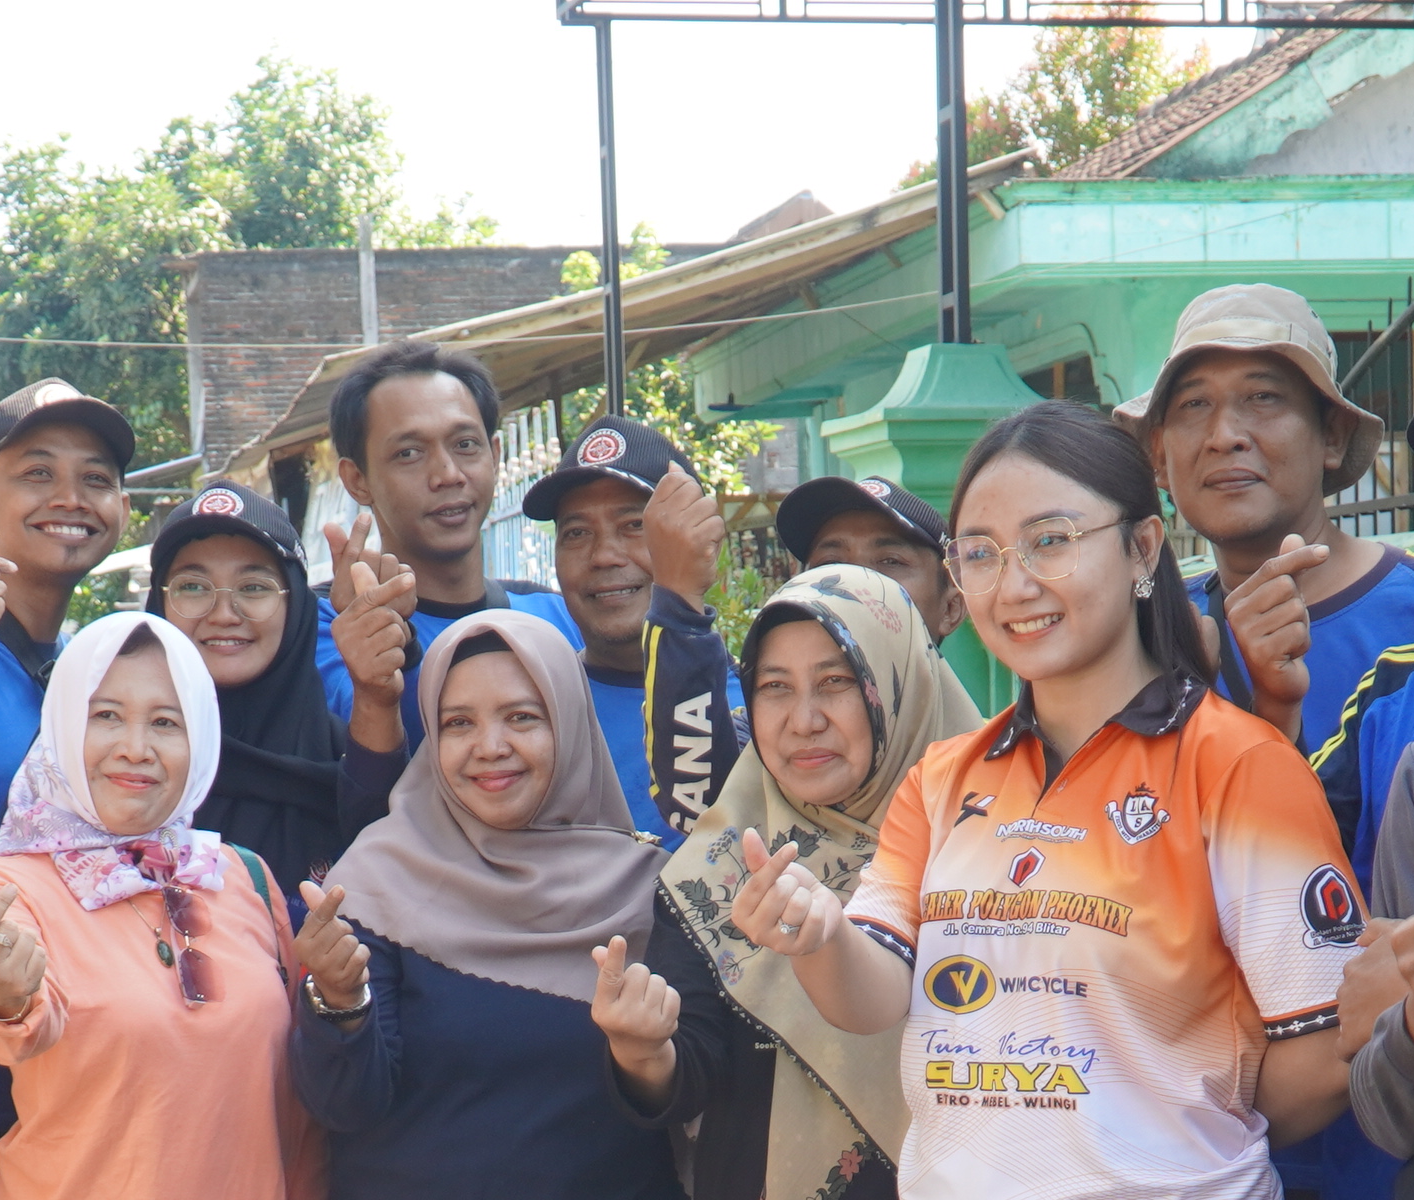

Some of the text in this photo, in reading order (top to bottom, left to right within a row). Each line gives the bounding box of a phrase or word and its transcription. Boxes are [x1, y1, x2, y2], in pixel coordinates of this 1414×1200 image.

[995, 818, 1089, 841] NORTHSOUTH
[969, 888, 1045, 921] POLYGON
[1043, 890, 1132, 937] PHOENIX
[961, 922, 1005, 937] Cemara
[1007, 923, 1033, 936] No.94
[1035, 922, 1070, 936] Blitar
[998, 1031, 1100, 1074] Victory
[926, 1061, 1090, 1094] SURYA
[1023, 1097, 1077, 1111] WLINGI
